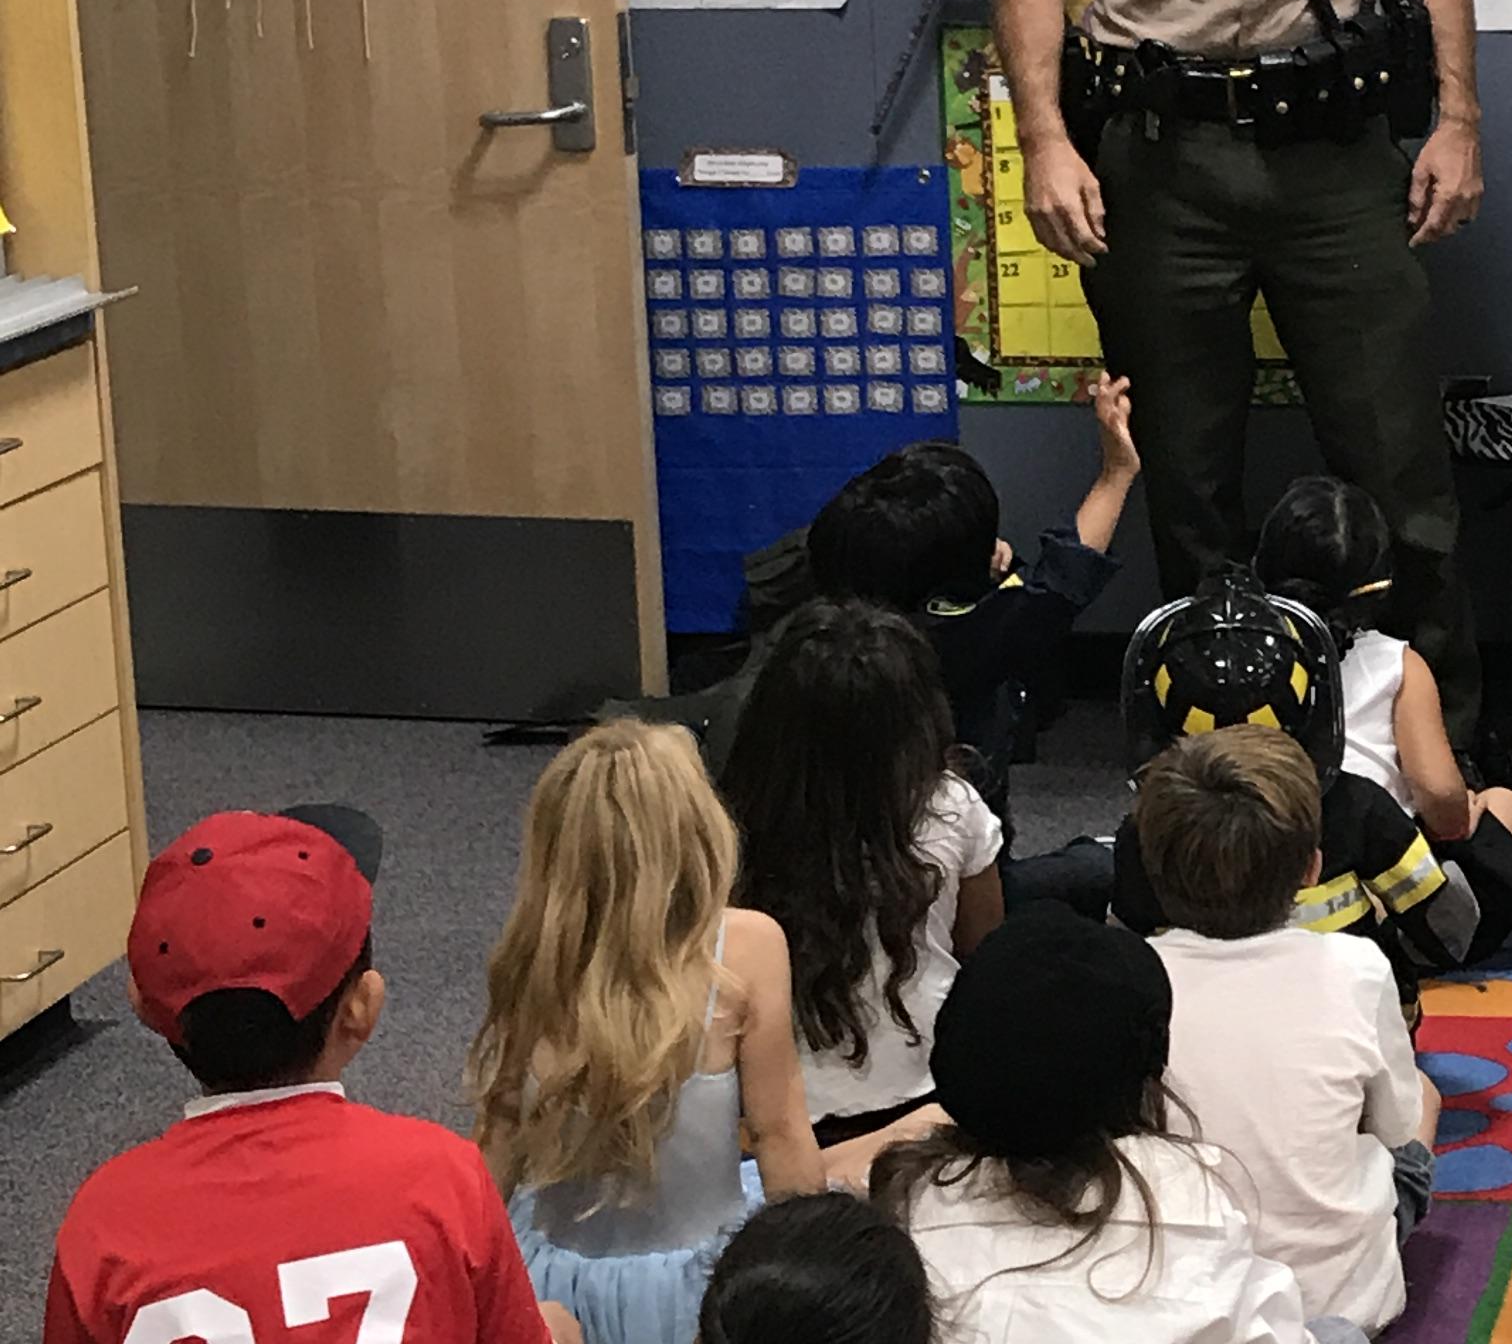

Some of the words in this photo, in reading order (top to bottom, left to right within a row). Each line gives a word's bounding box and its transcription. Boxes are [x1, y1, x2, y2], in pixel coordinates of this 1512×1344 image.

[1000, 160, 1010, 174] 8
[998, 210, 1013, 225] 15
[1001, 263, 1020, 277] 22
[1052, 263, 1069, 278] 23
